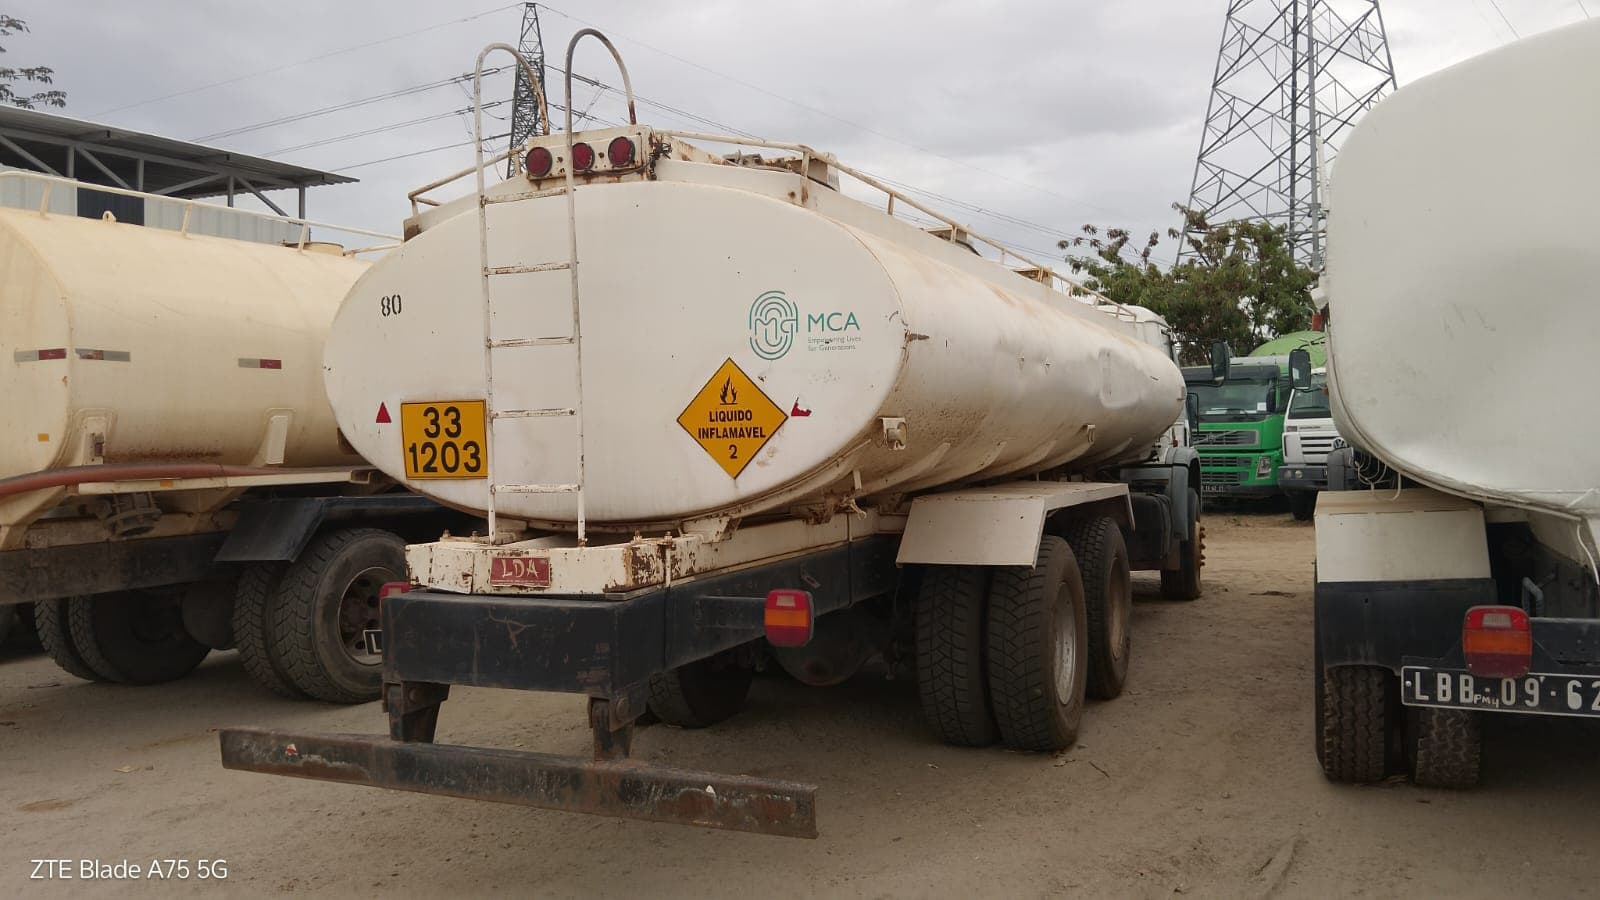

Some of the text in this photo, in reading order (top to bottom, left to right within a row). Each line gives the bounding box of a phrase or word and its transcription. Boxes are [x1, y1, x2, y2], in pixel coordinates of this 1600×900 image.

[381, 294, 402, 317] 80
[808, 312, 860, 332] MCA
[423, 406, 462, 438] 33
[409, 440, 481, 473] 1203
[728, 444, 738, 459] 2
[501, 559, 540, 578] LDA
